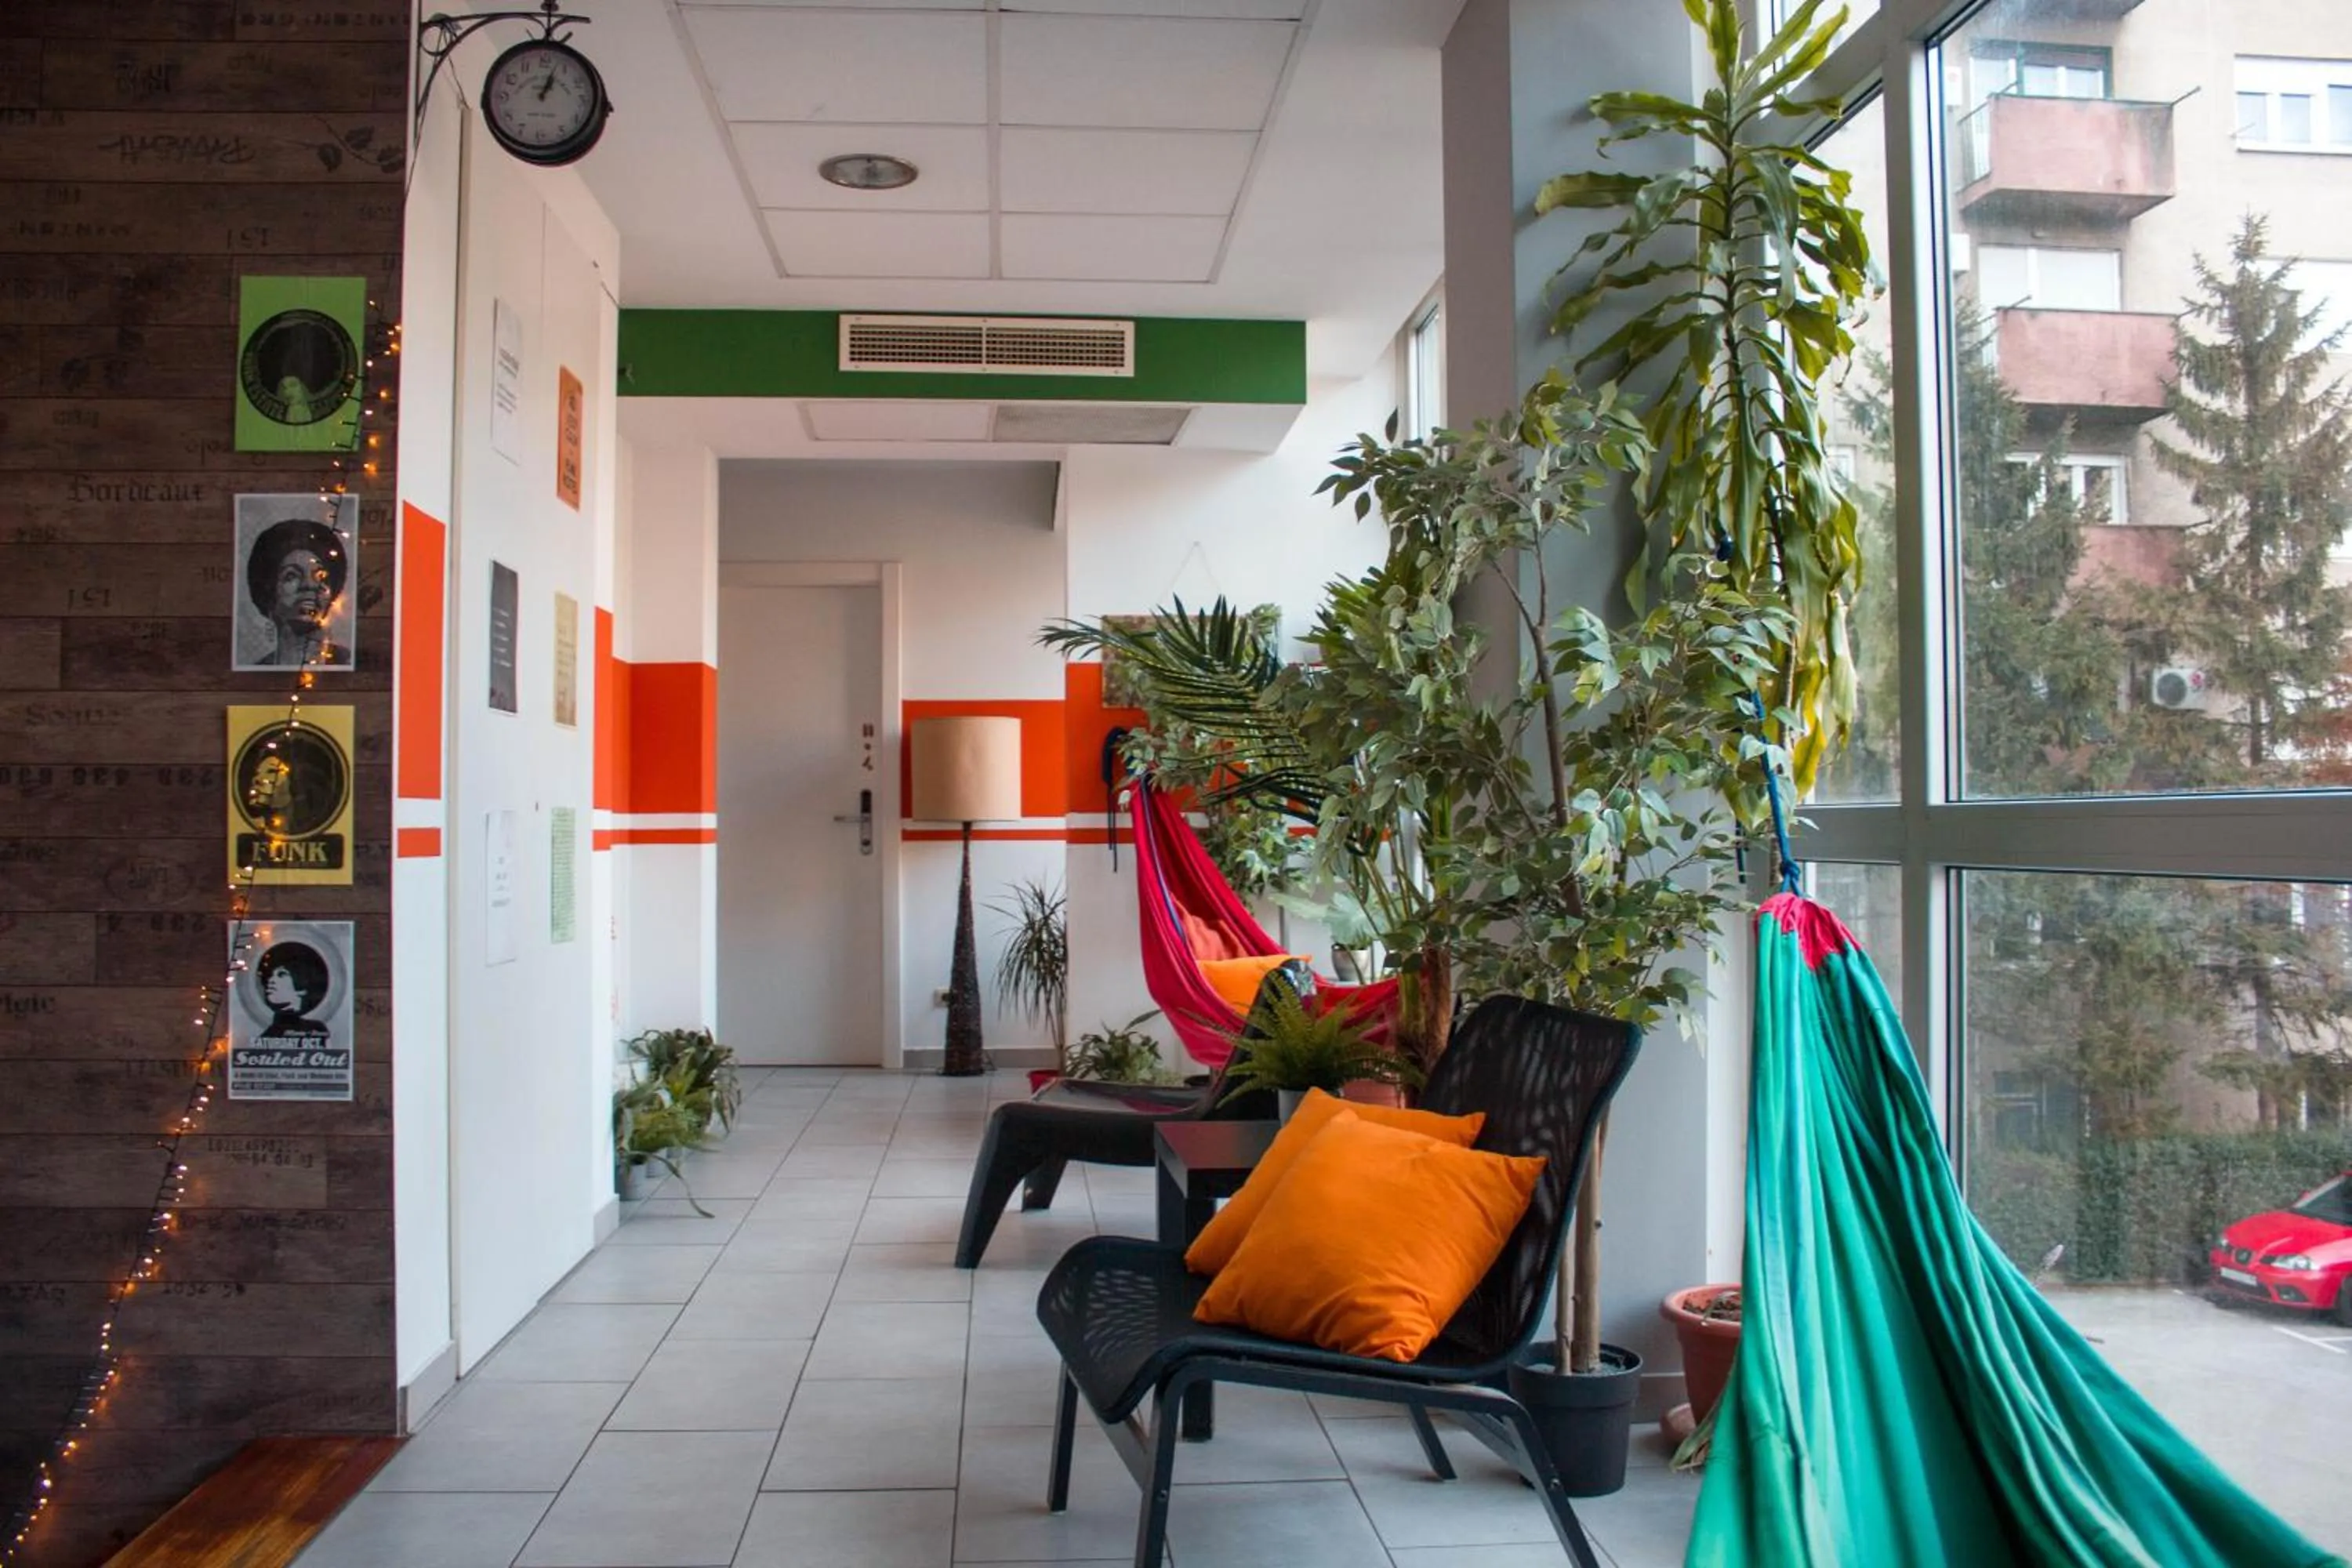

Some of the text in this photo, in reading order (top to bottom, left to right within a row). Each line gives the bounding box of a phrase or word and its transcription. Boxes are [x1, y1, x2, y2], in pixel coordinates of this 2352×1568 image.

[252, 840, 328, 862] FUNK
[234, 1051, 348, 1068] Souled Out
